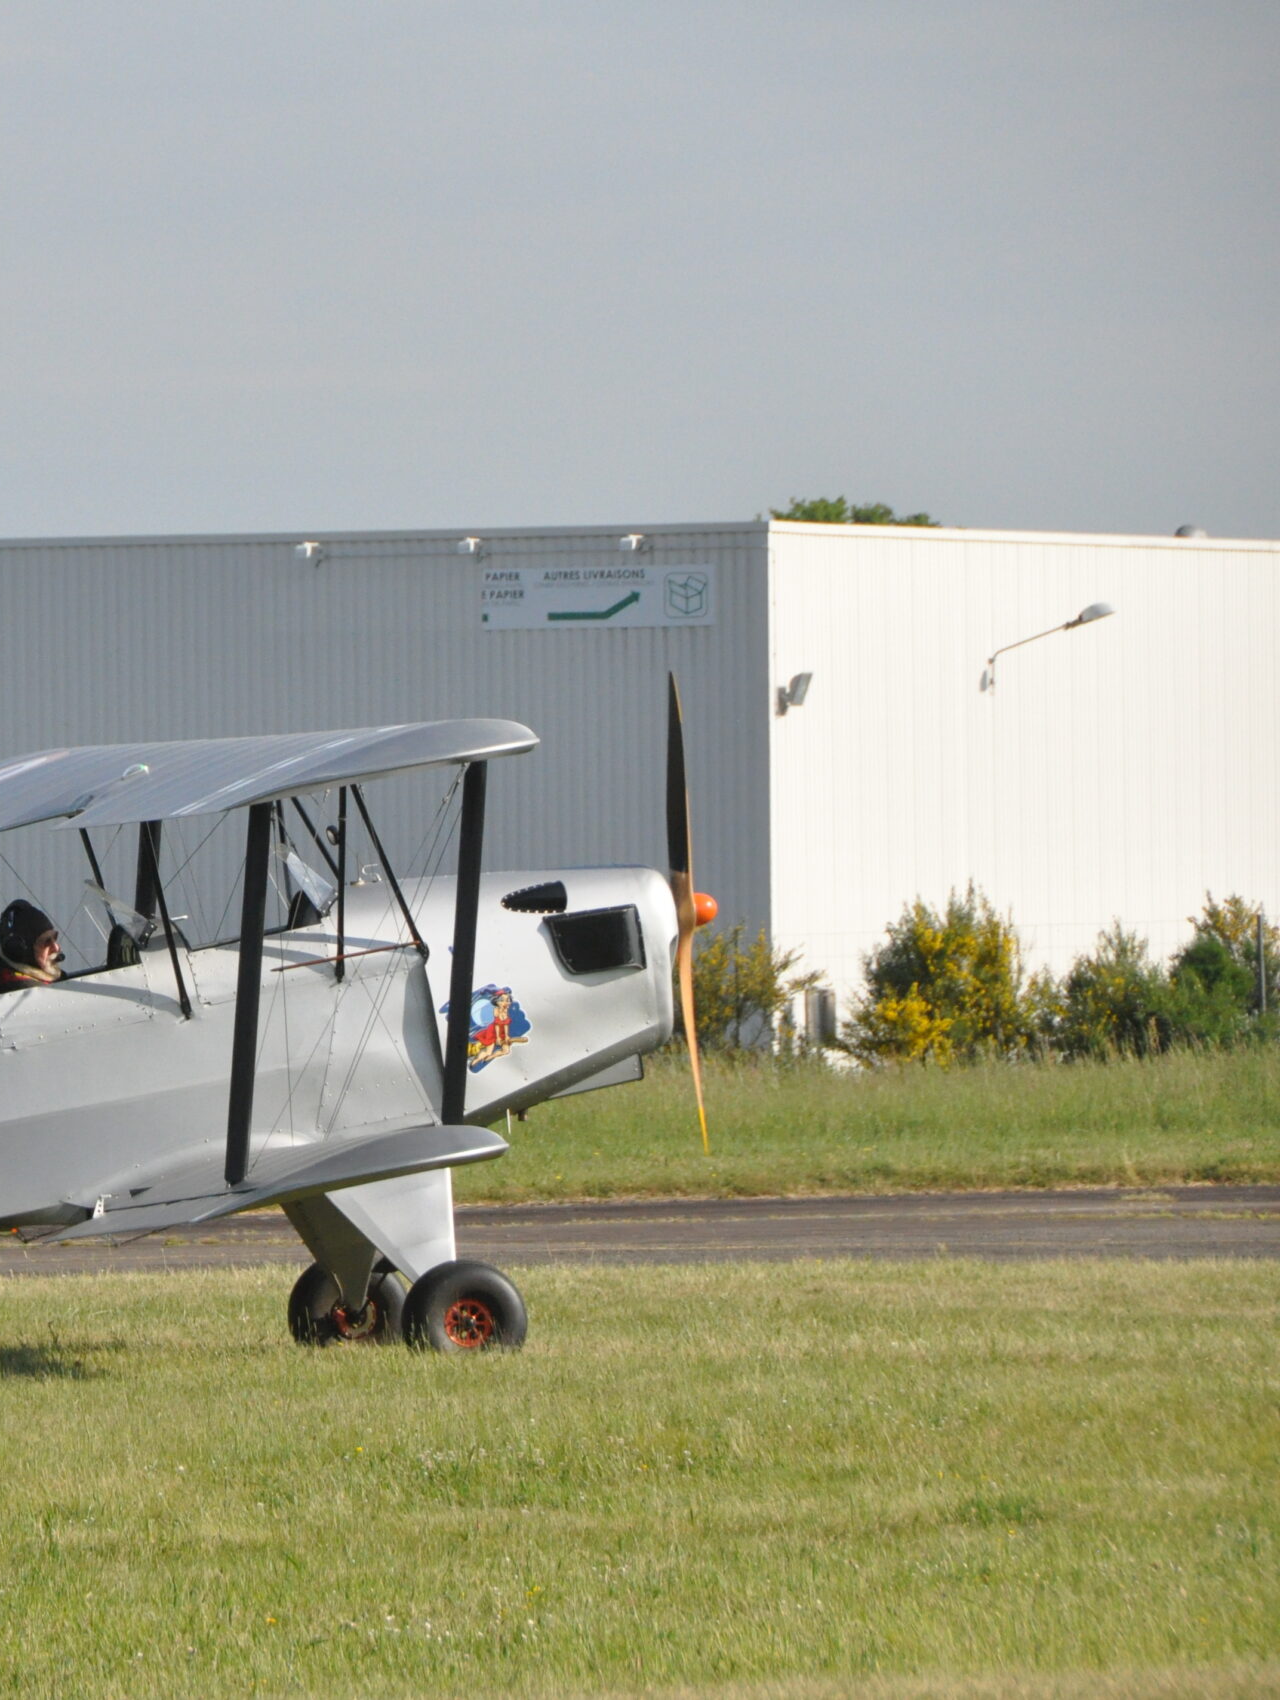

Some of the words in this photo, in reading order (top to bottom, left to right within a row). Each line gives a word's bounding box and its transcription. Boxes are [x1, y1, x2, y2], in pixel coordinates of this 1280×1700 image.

[485, 571, 520, 581] PAPIER
[543, 570, 580, 581] AUTRES
[583, 568, 646, 580] LIVRAISONS
[489, 589, 525, 600] PAPIER
